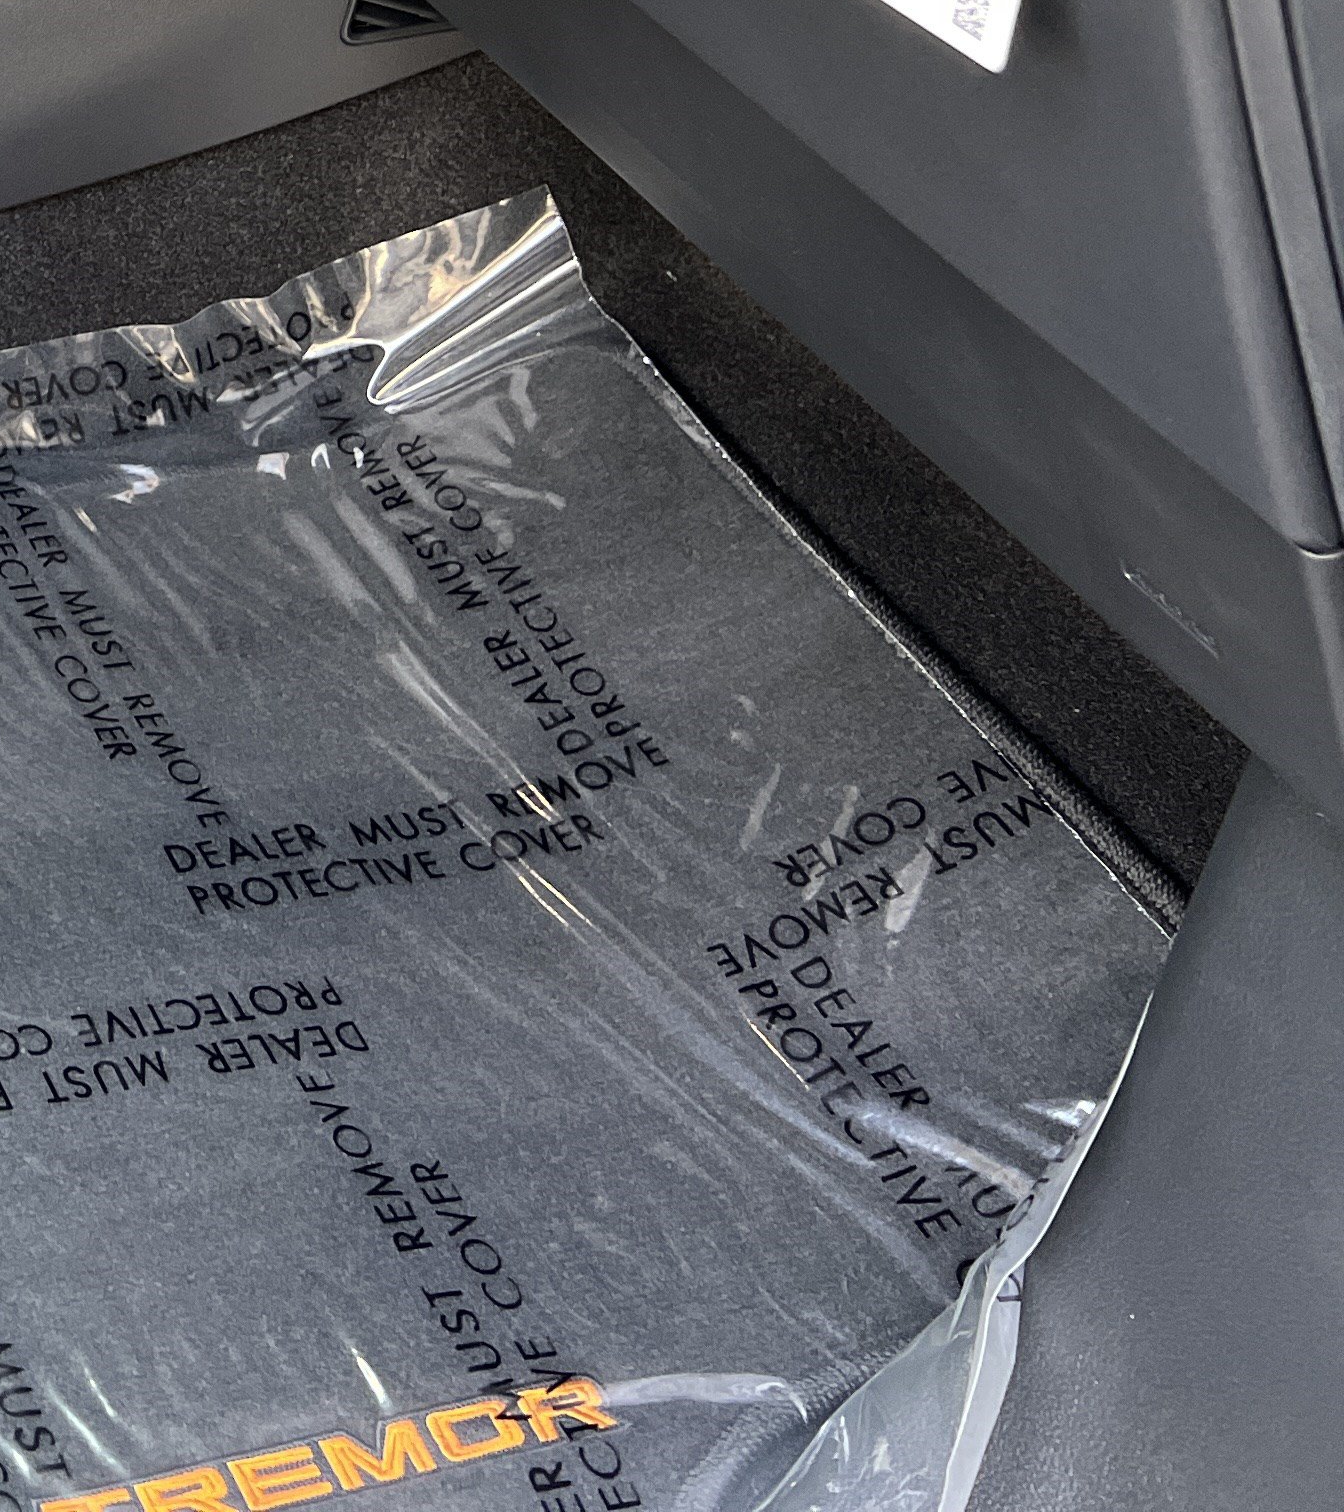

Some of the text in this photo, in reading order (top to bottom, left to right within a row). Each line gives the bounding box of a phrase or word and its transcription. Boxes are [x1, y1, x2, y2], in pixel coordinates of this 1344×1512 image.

[2, 360, 129, 410] COVER
[315, 386, 592, 759] DEALER MUST REMOVE
[399, 434, 650, 742] PROTECTIVE COVER
[55, 656, 140, 761] COVER
[58, 589, 133, 676] MUST
[123, 694, 231, 828] REMOVE
[164, 735, 669, 875] DEALER MUST REMOVE
[187, 812, 604, 916] PROTECTIVE COVER
[772, 796, 928, 888] COVER
[707, 792, 1056, 978] MUST REMOVE
[46, 1049, 169, 1107] MUST
[79, 976, 344, 1049] PROTECTIVE
[196, 1019, 369, 1076] DEALER
[791, 955, 932, 1111] DEALER
[296, 1070, 433, 1253] REMOVE
[738, 980, 960, 1240] PROTECTIVE
[411, 1159, 523, 1309] COVER
